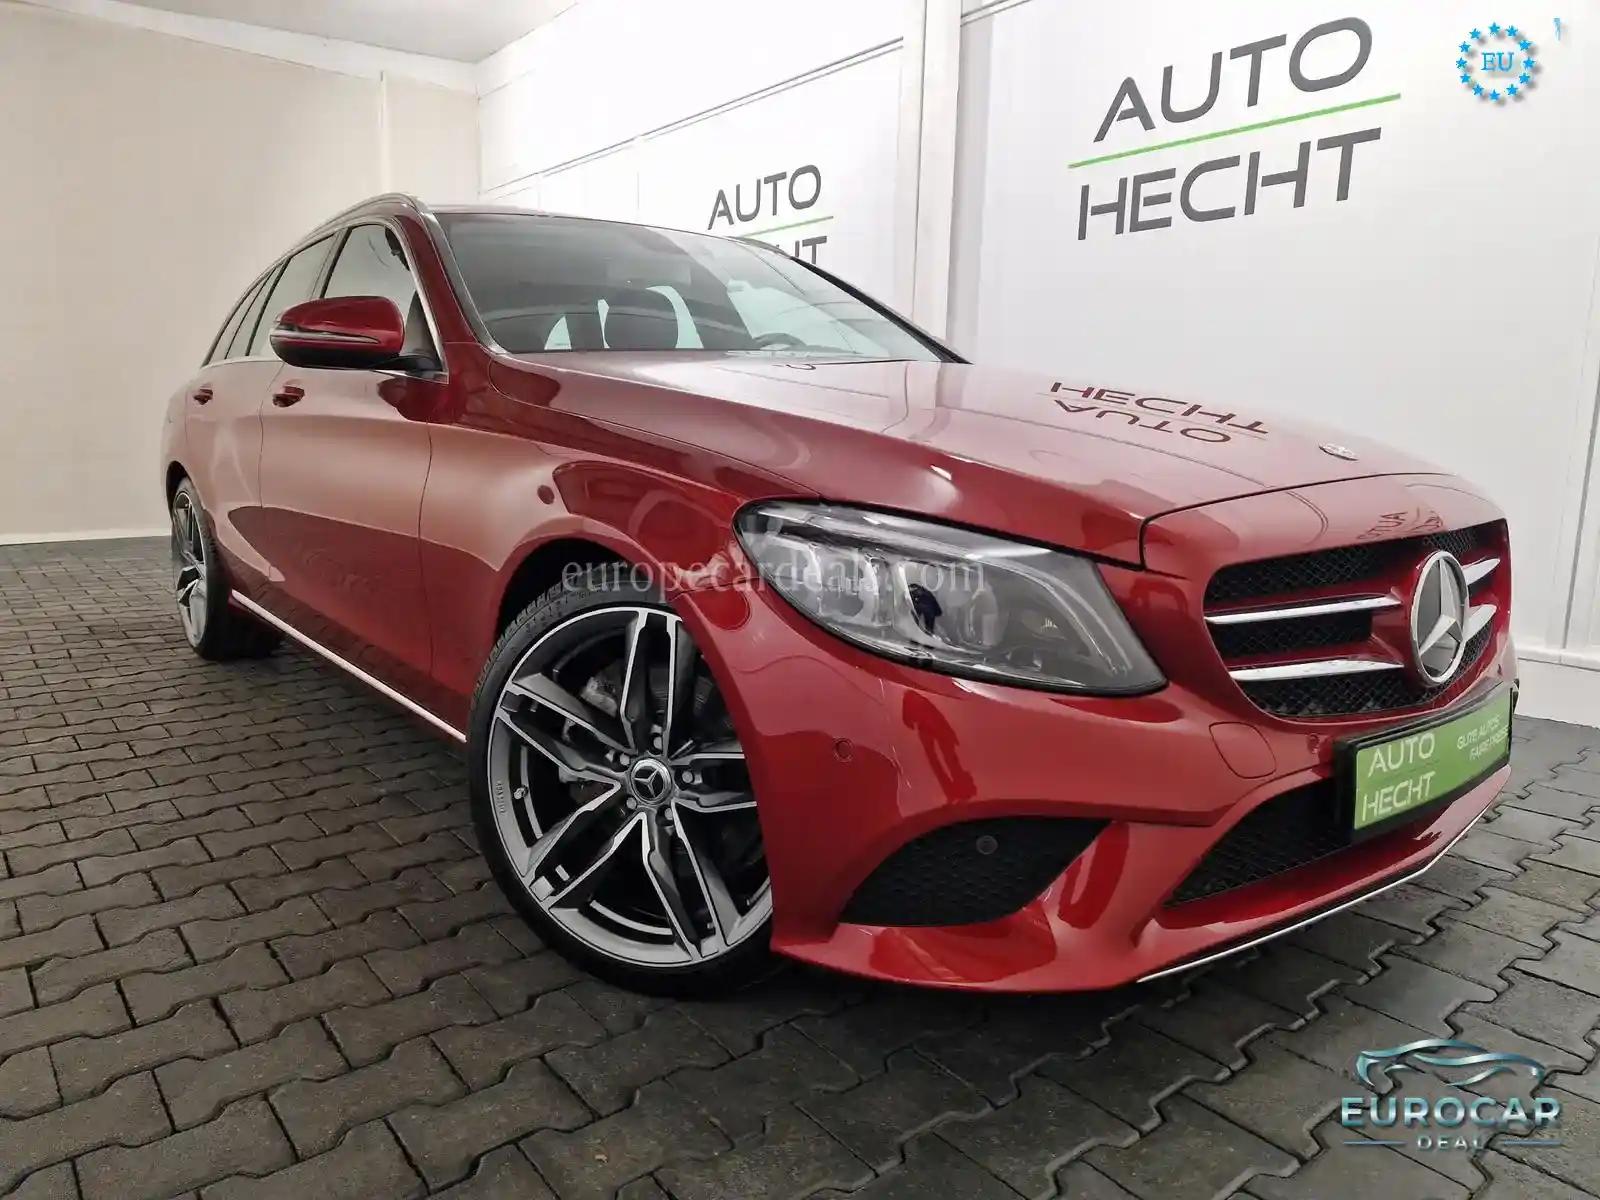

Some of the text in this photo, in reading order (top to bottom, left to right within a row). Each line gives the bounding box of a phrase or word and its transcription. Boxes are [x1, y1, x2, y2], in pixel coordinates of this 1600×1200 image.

[1092, 17, 1373, 143] AUTO
[707, 164, 822, 231] AUTO
[1077, 127, 1382, 241] HECHT
[1368, 732, 1435, 779] AUTO
[1362, 771, 1436, 822] HECHT
